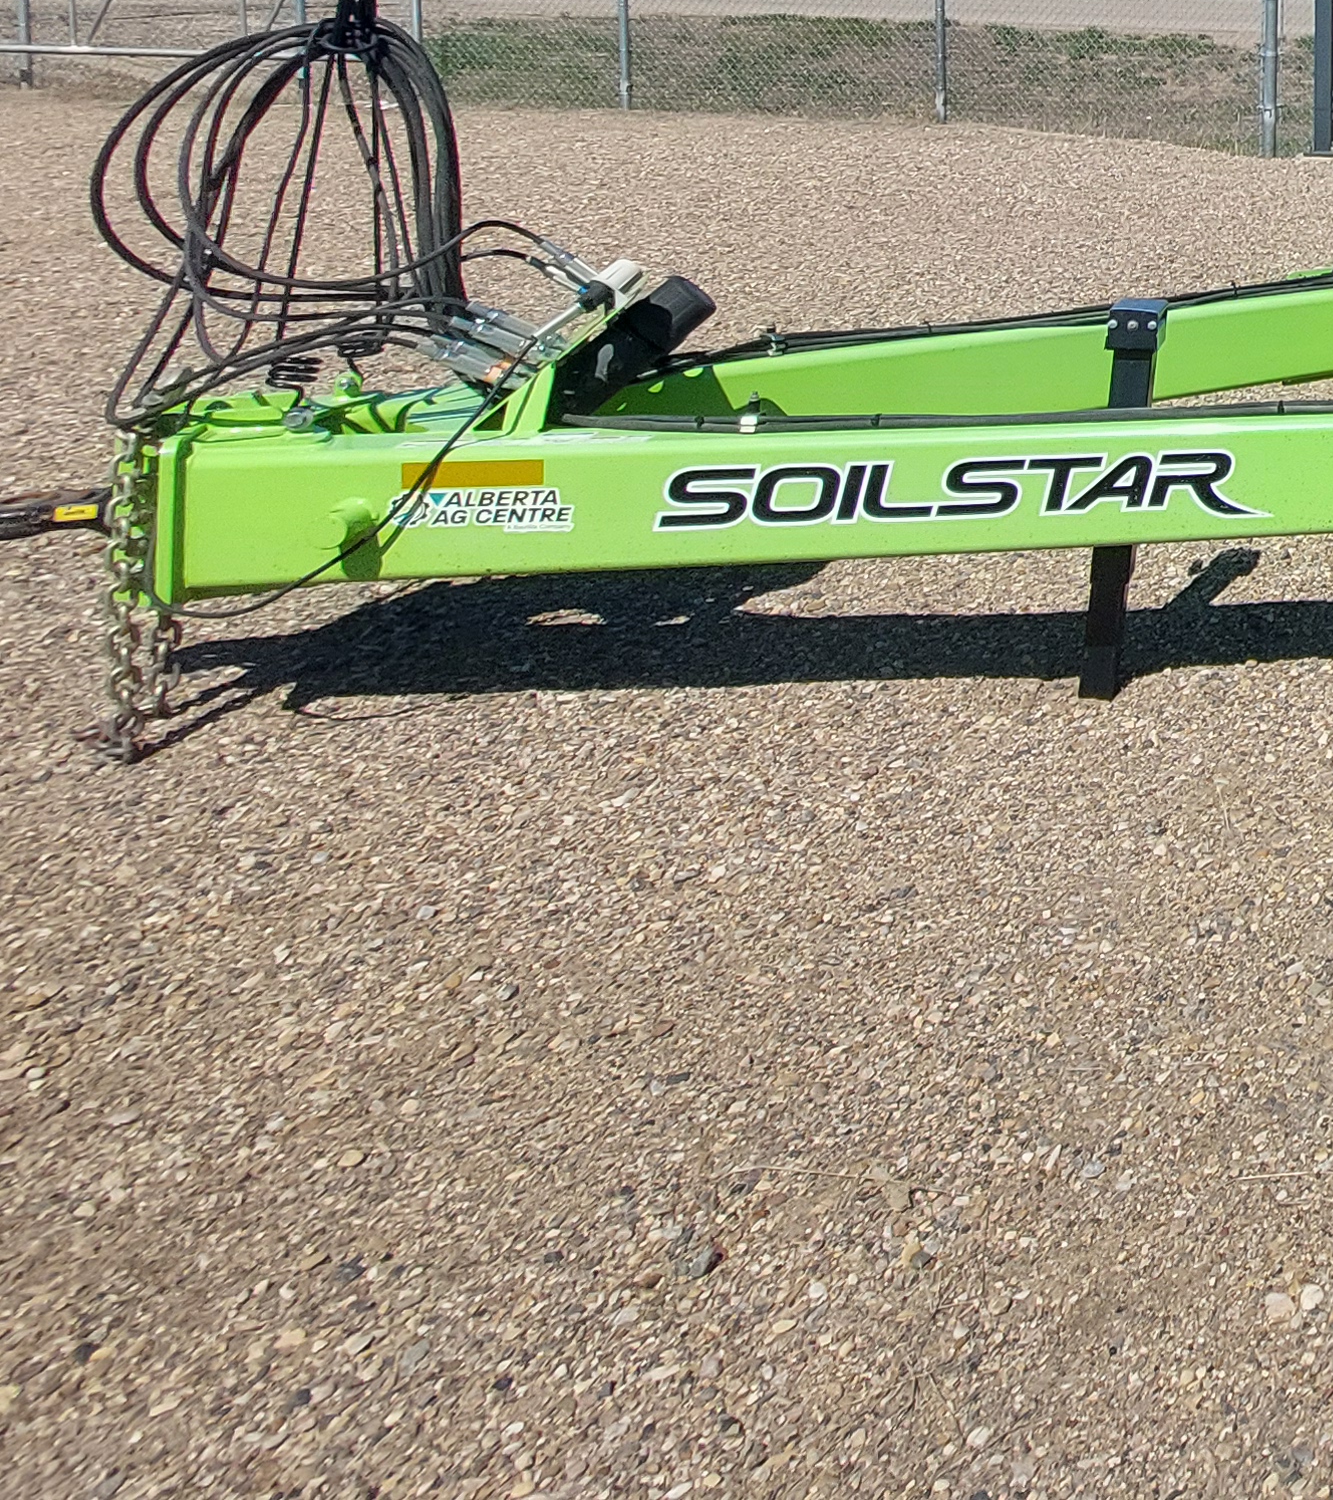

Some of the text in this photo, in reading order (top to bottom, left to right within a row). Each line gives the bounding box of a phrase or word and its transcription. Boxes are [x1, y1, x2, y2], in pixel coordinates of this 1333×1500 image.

[444, 490, 558, 508] ALBERTA
[653, 451, 1273, 530] SOILSTAR
[431, 507, 572, 525] AG CENTRE
